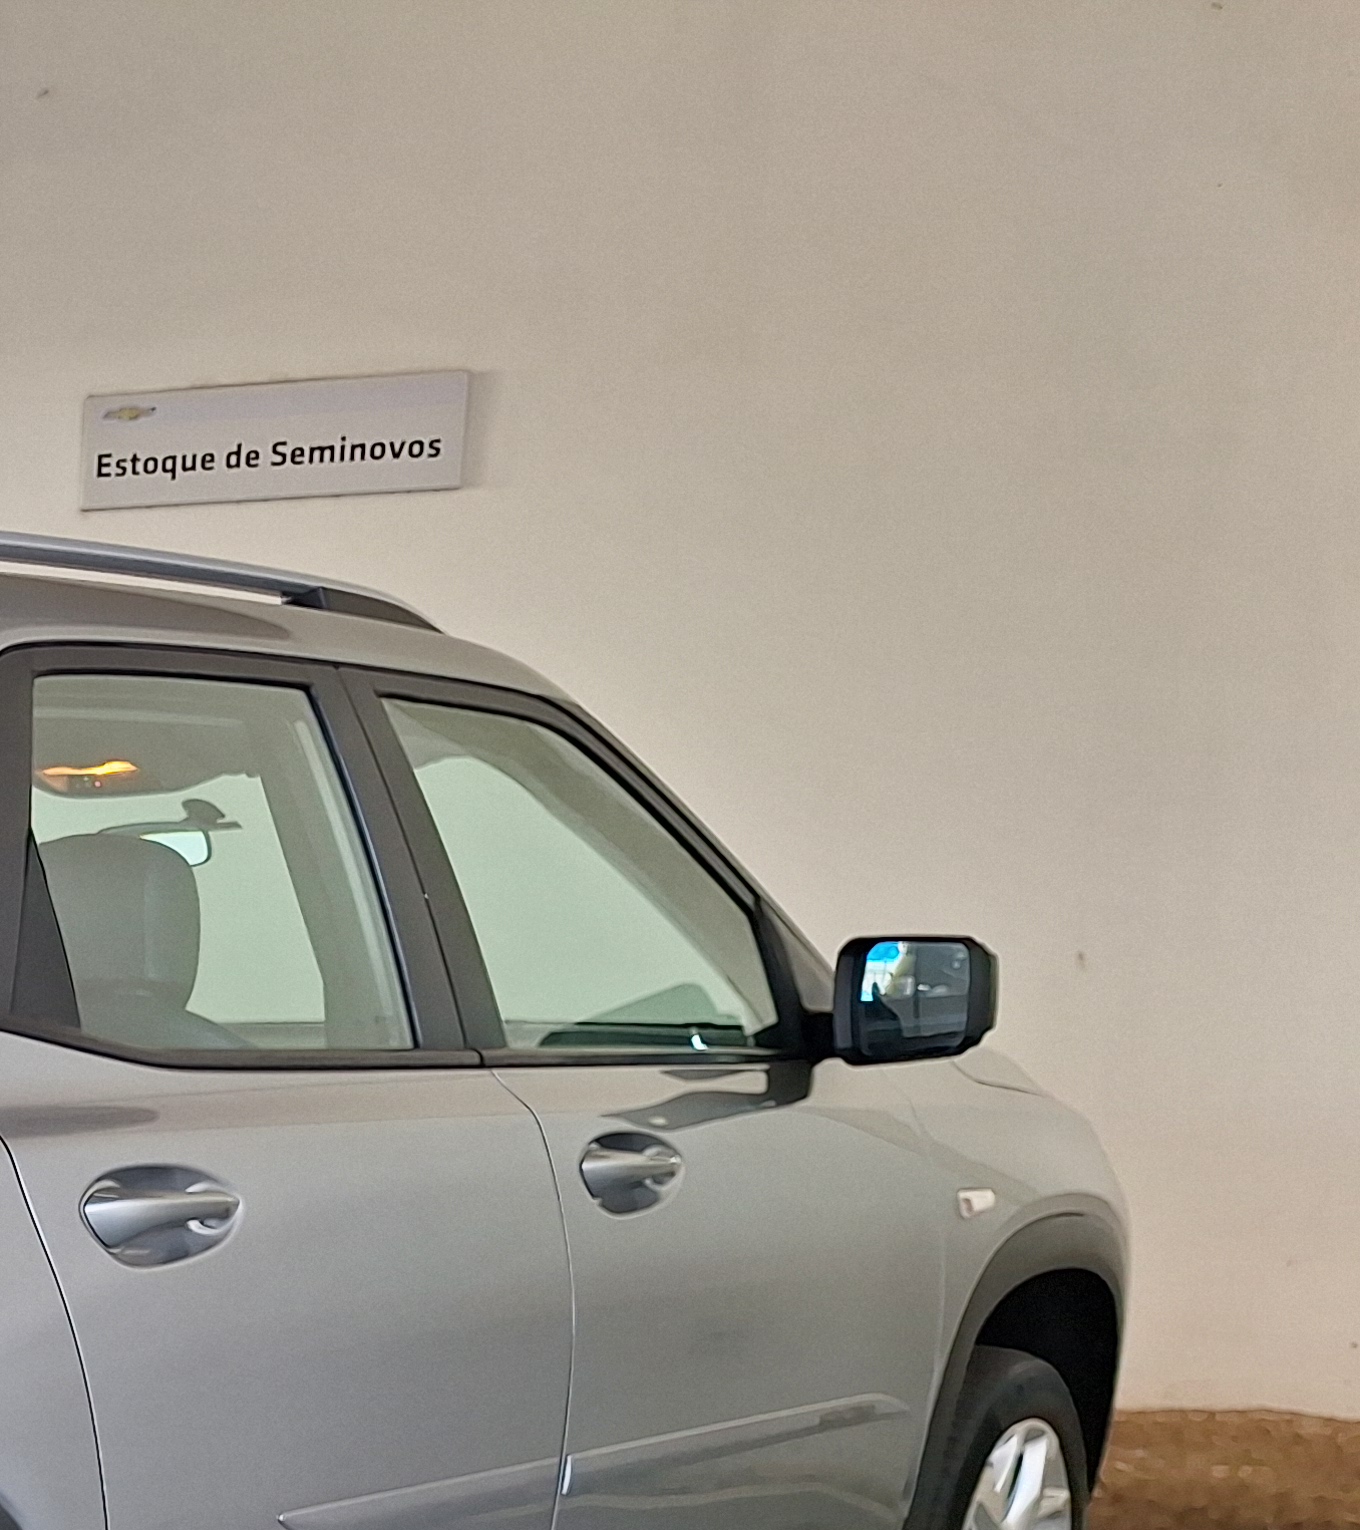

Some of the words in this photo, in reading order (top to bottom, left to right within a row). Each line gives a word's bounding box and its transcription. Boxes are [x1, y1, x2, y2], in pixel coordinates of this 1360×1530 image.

[96, 451, 216, 481] Estoque
[225, 442, 261, 469] de
[270, 435, 443, 467] Seminovos
